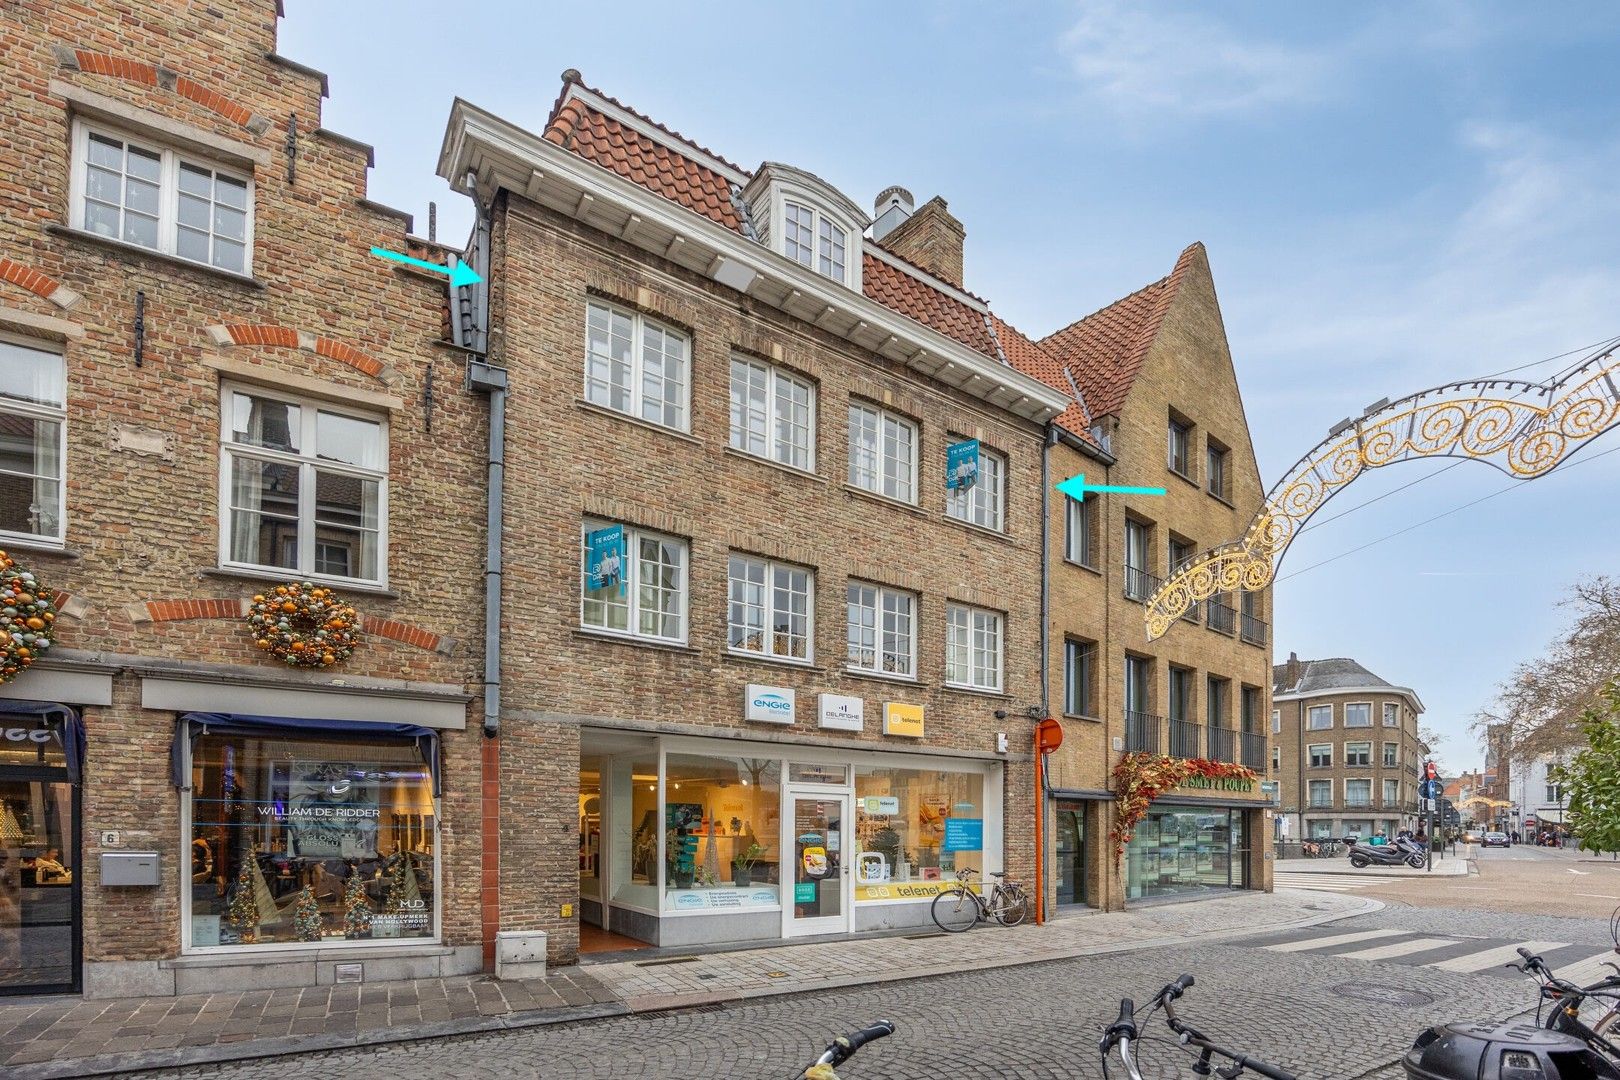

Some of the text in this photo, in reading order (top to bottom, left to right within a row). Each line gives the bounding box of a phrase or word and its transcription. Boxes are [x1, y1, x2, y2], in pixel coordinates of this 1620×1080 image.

[959, 445, 976, 453] KOOP
[603, 532, 620, 542] KOOP
[257, 806, 380, 818] WILLIAM DE RIDDER
[107, 834, 114, 843] 6
[896, 885, 941, 897] telenet
[400, 899, 425, 908] MUD
